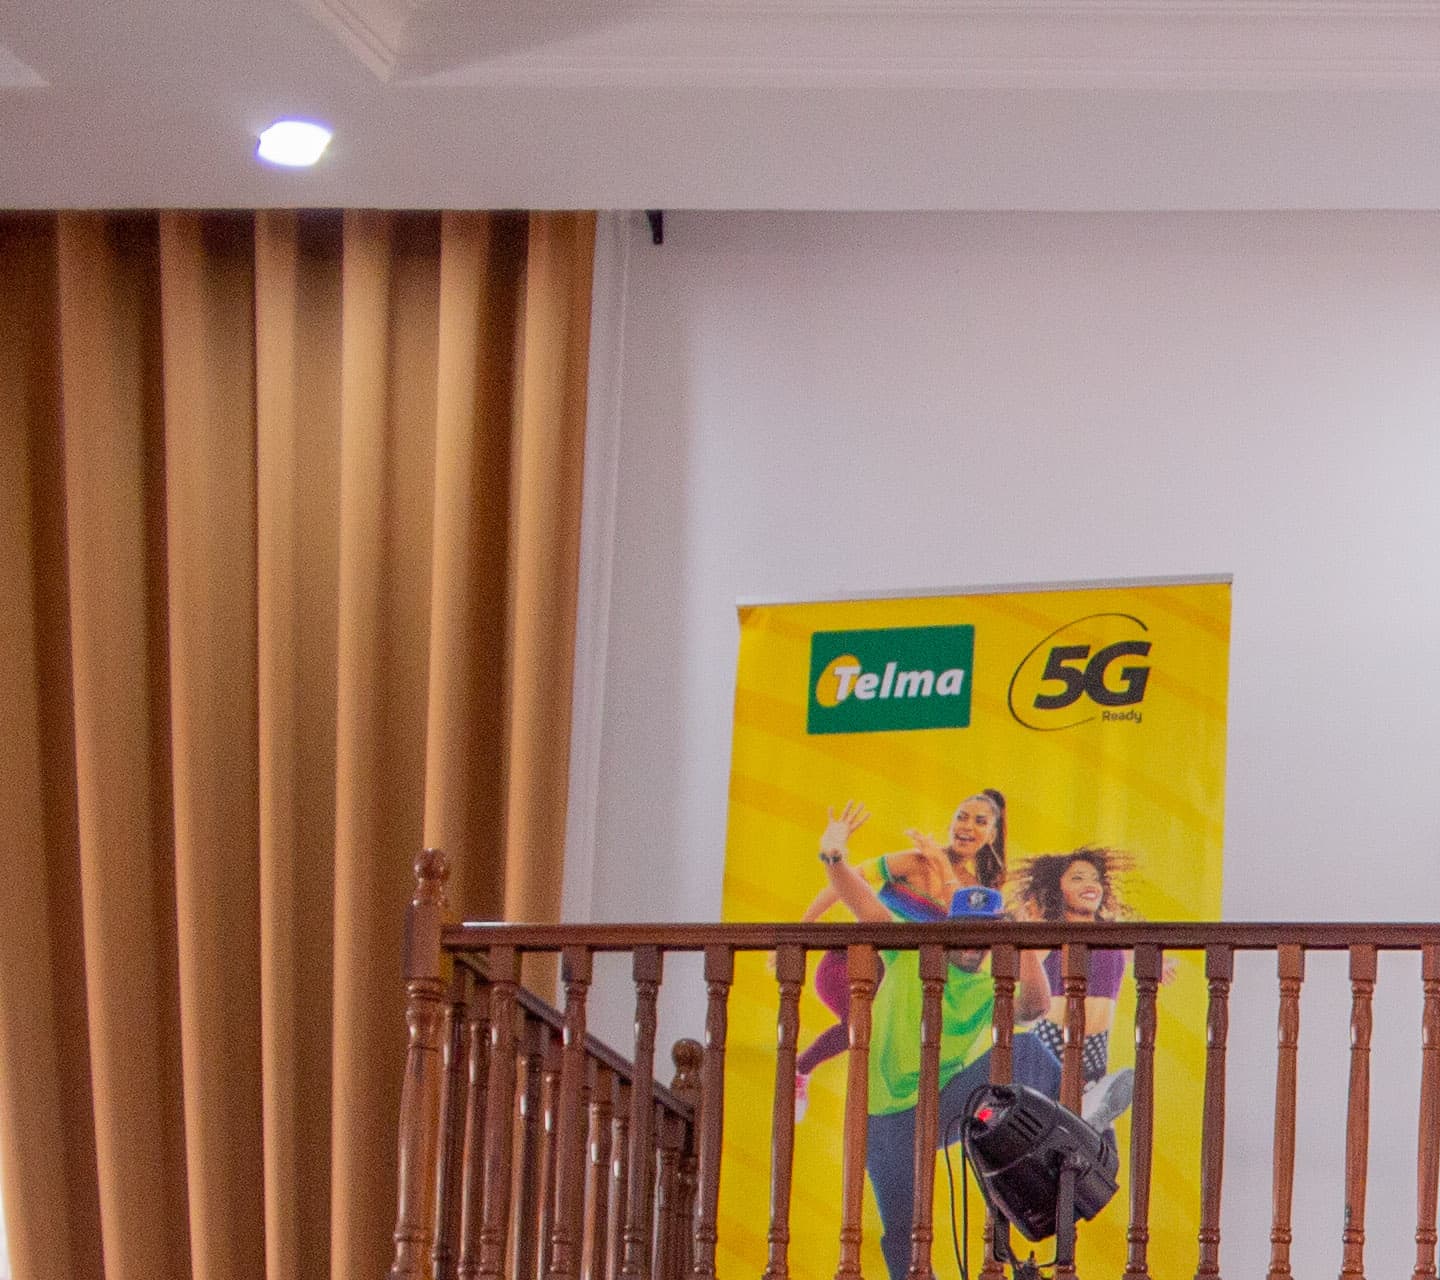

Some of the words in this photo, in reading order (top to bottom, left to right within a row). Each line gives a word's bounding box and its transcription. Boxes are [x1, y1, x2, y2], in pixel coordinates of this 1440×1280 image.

[834, 662, 964, 701] Telma
[1033, 640, 1152, 709] 5G
[1102, 709, 1143, 723] Ready
